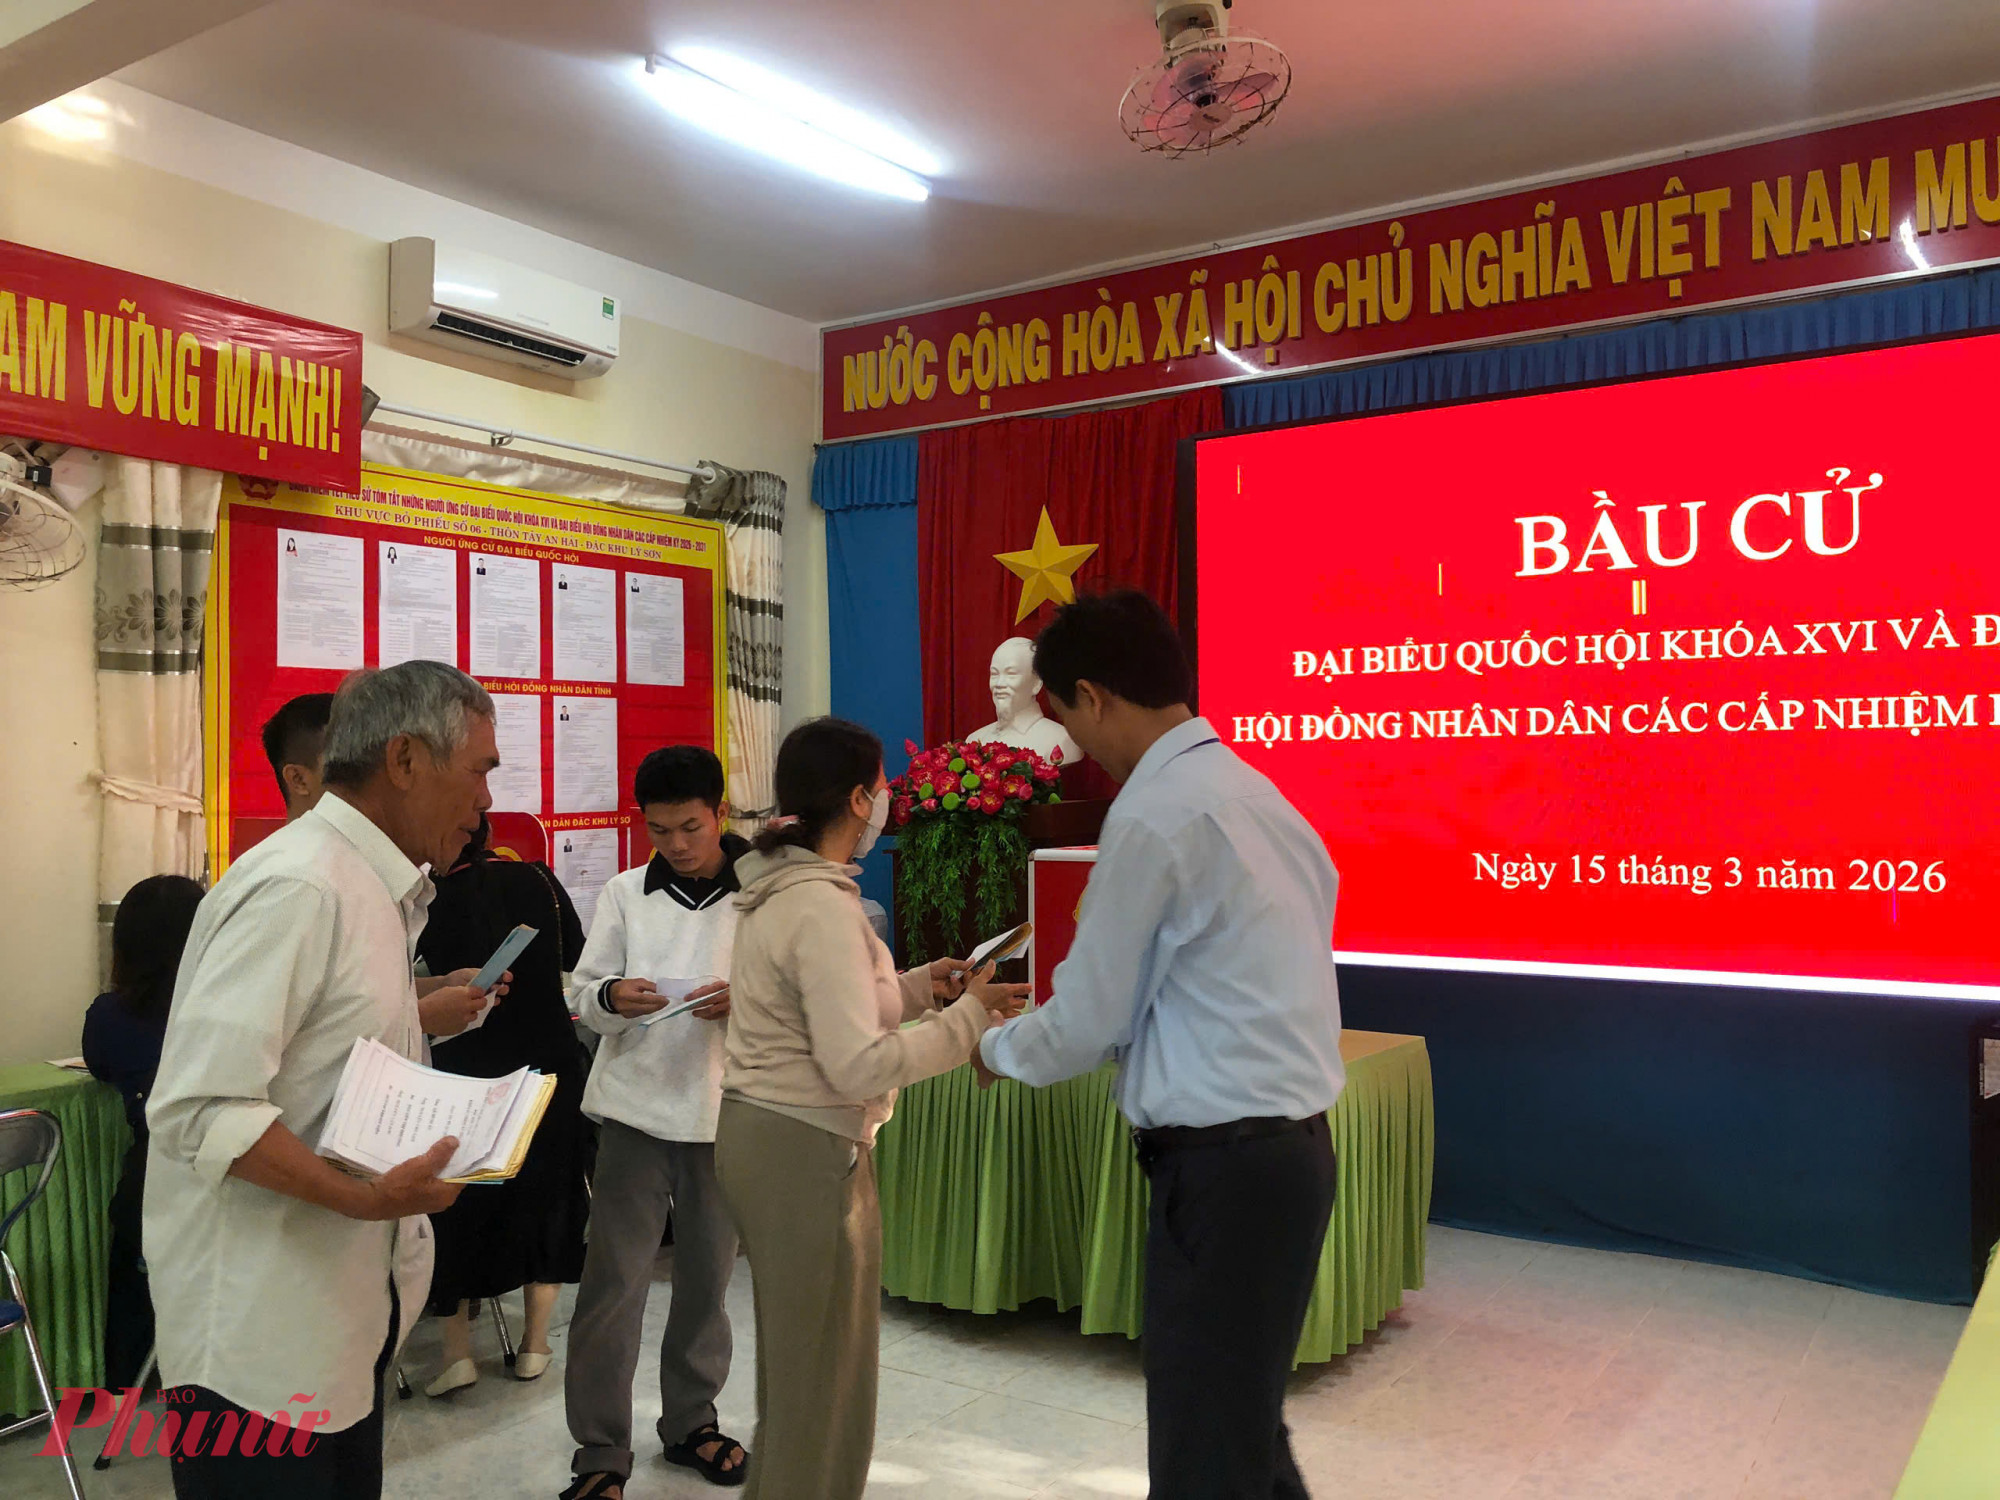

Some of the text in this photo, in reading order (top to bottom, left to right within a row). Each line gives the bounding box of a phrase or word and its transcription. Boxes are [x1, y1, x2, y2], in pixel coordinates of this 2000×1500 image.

[843, 136, 2000, 412] NƯỚC CỘNG HÒA XÃ HỘI CHỦ NGHĨA VIỆT NAM MU
[0, 290, 342, 461] AM VỮNG MẠNH!
[335, 505, 362, 518] KHU
[365, 509, 391, 523] VỰC
[394, 511, 411, 524] BỎ
[414, 516, 451, 530] PHIẾU
[453, 520, 468, 532] SỐ
[470, 525, 482, 534] 06
[489, 526, 520, 539] THÔN
[522, 530, 541, 542] TÂY
[544, 536, 558, 545] AN
[561, 535, 578, 548] HẢI
[586, 540, 605, 552] ĐẶC
[608, 544, 628, 555] KHU
[630, 545, 642, 556] LÝ
[643, 549, 662, 559] SƠN
[424, 535, 579, 564] NGƯỜI ỨNG CỬ ĐẠI BIỂU QUỐC HỘI
[1514, 466, 1884, 577] BẦU CỬ
[1292, 647, 1355, 683] ĐẠI
[1360, 636, 1449, 674] BIỂU
[1455, 629, 1568, 676] QUỐC
[1574, 628, 1652, 671] HỘI
[1660, 619, 1788, 661] KHÓA
[1792, 619, 1878, 655] XVI
[1886, 608, 1961, 651] VÀ
[483, 678, 502, 691] BIỂU
[504, 682, 520, 694] HỘI
[522, 680, 548, 693] ĐỒNG
[550, 683, 573, 694] NHÂN
[575, 684, 592, 695] DÂN
[1232, 711, 1294, 749] HỘI
[1299, 705, 1403, 741] ĐỒNG
[1408, 702, 1520, 739] NHÂN
[1526, 699, 1614, 736] DÂN
[1621, 696, 1709, 734] CÁC
[1717, 691, 1805, 732] CẤP
[1812, 690, 1979, 737] NHIỆM
[620, 815, 631, 824] SƠ
[1471, 852, 1947, 895] Ngày 15 tháng 3 năm 2026
